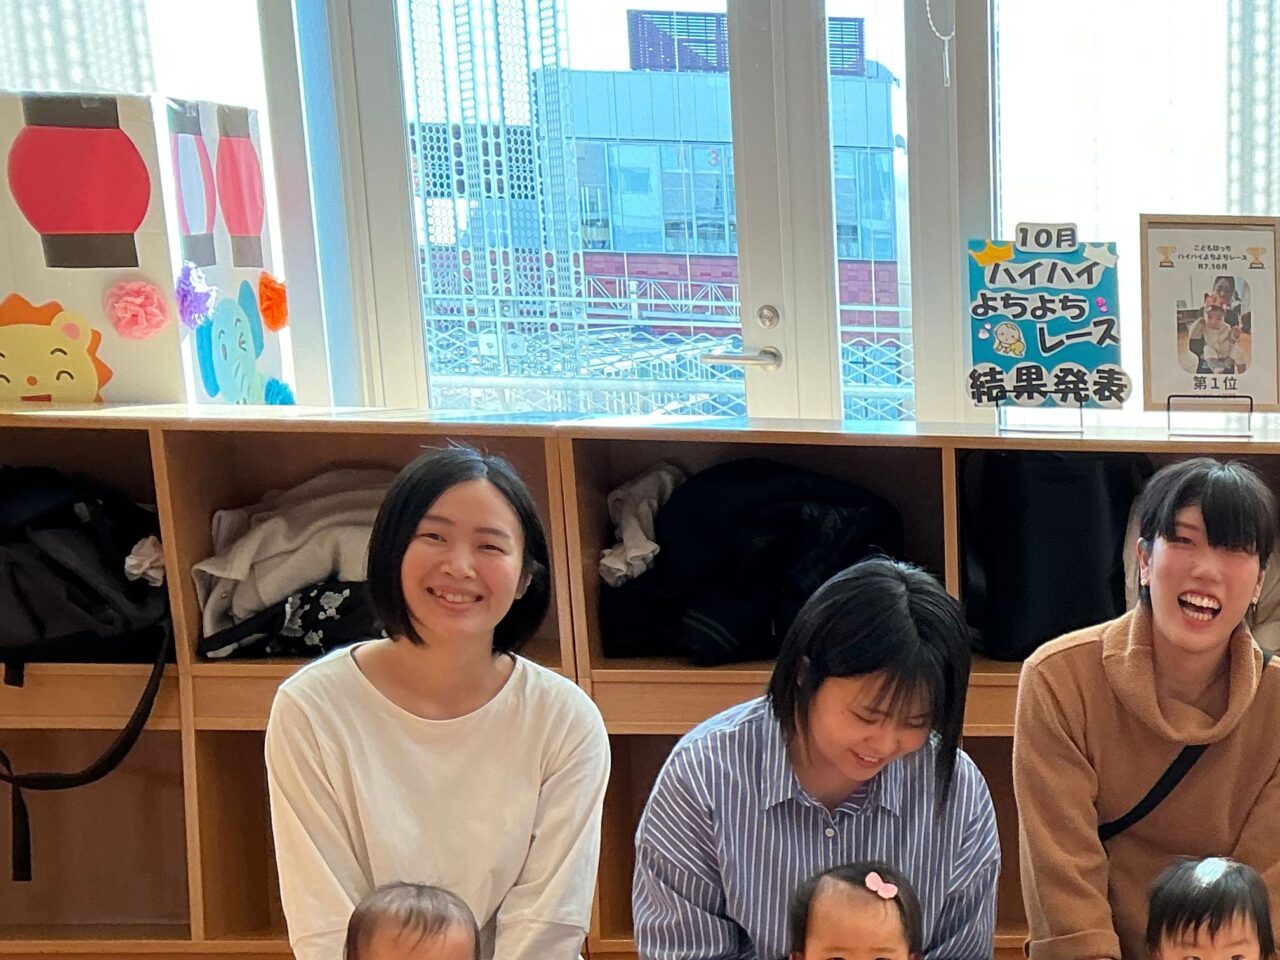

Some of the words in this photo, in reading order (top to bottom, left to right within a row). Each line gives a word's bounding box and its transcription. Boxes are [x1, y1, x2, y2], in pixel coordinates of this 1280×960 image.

[1018, 226, 1078, 249] 10月
[1177, 253, 1249, 262] ハイハイよちよちレース
[988, 261, 1101, 286] ハイハイ
[971, 292, 1088, 321] よちよち
[1038, 317, 1120, 354] レース
[968, 364, 1128, 403] 結果発表
[1193, 375, 1238, 391] 第1位
